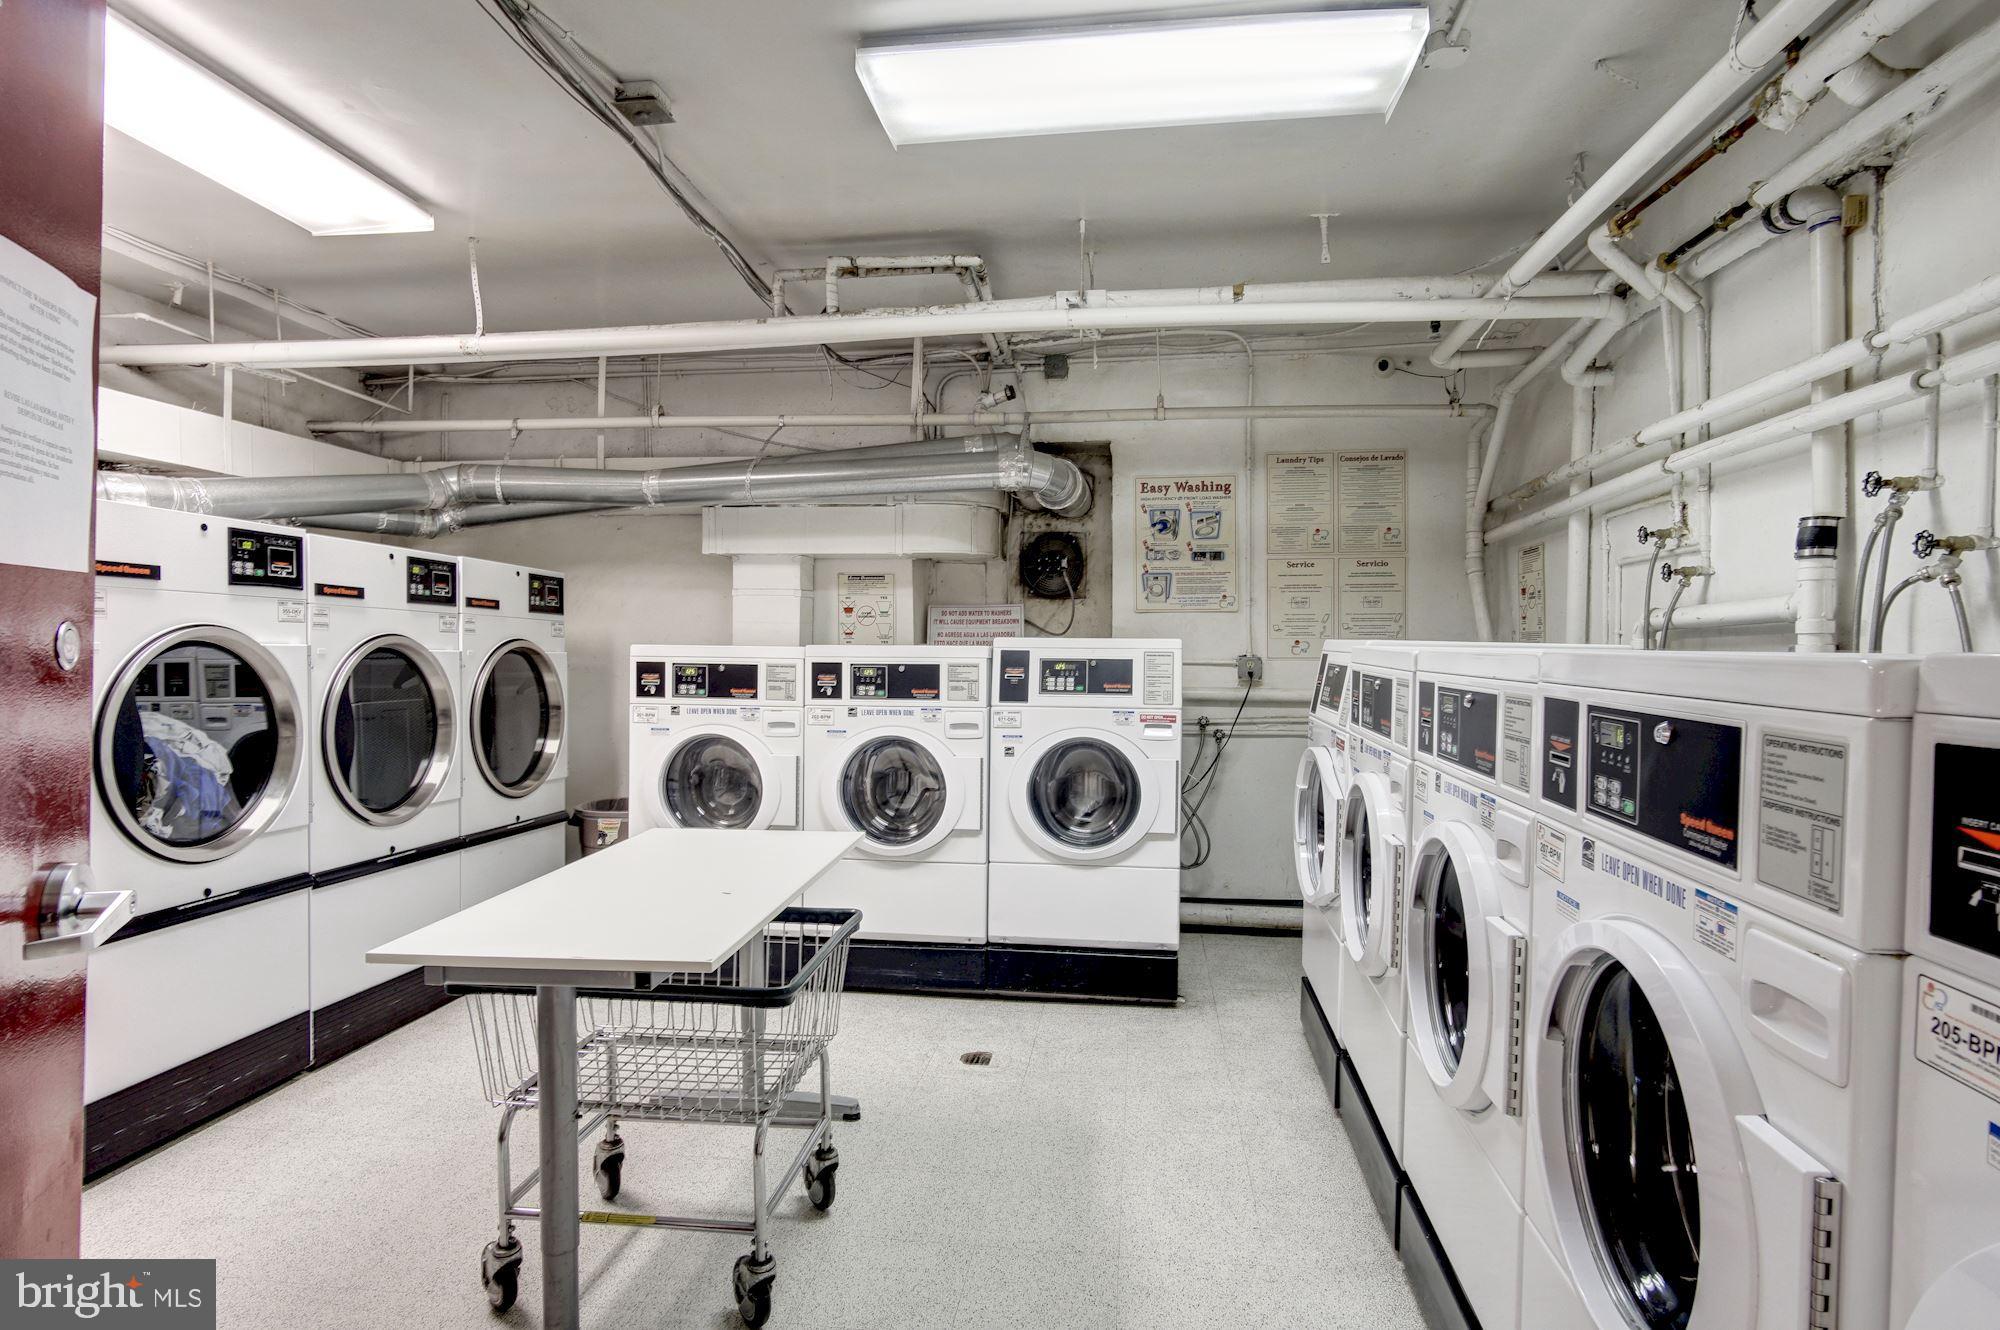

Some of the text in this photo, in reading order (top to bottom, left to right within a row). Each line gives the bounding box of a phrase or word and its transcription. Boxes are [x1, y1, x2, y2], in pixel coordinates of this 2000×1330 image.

[1276, 456, 1324, 465] Laundry Tips
[1340, 454, 1404, 464] Consejos de Lavado
[1140, 480, 1232, 496] Easy Washing
[1286, 561, 1316, 569] Service
[1356, 560, 1389, 568] Servicio
[686, 707, 700, 715] LEAVE
[1765, 738, 1844, 760] OPERATING INSTRUCTIONS
[1763, 800, 1841, 827] DISPENSER INSTRUCTIONS
[1680, 812, 1735, 841] Speed Queen
[1961, 817, 1989, 829] INSERT
[1539, 842, 1562, 862] 207-BPM
[1601, 853, 1687, 910] LEAVE OPEN WHEN DONE
[1931, 1016, 2000, 1065] 205-BP
